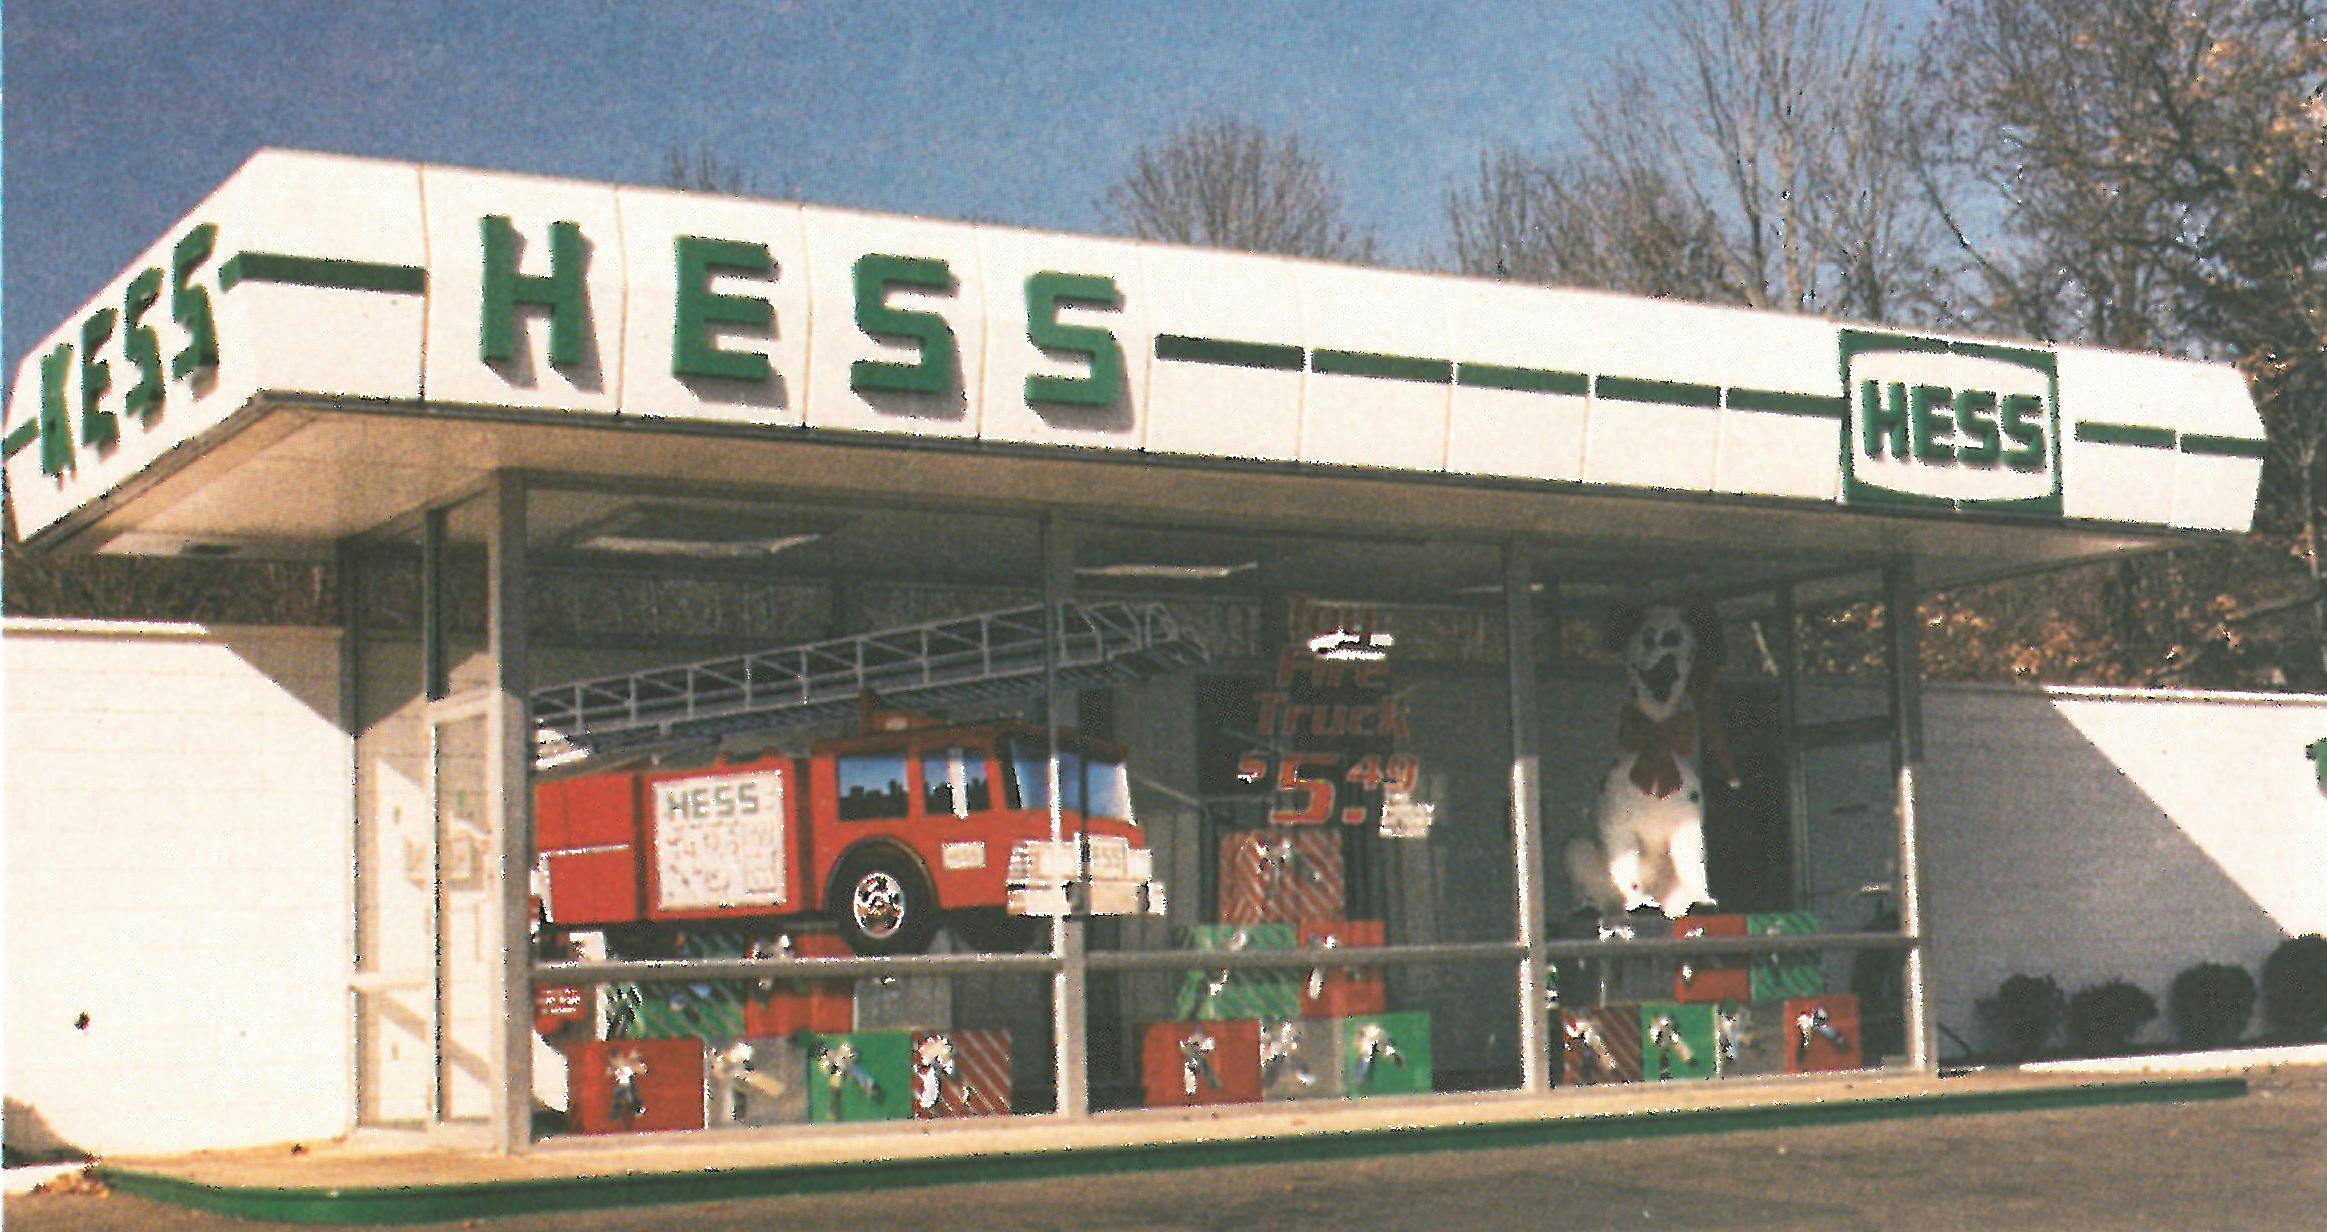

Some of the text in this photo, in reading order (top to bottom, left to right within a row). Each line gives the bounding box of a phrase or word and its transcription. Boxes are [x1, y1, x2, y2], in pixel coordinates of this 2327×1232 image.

[480, 215, 1126, 408] HESS
[39, 222, 219, 478] HESS
[1861, 379, 2047, 471] HESS
[1276, 646, 1390, 688] Fire
[1256, 690, 1412, 737] Truck
[665, 782, 760, 820] HESS
